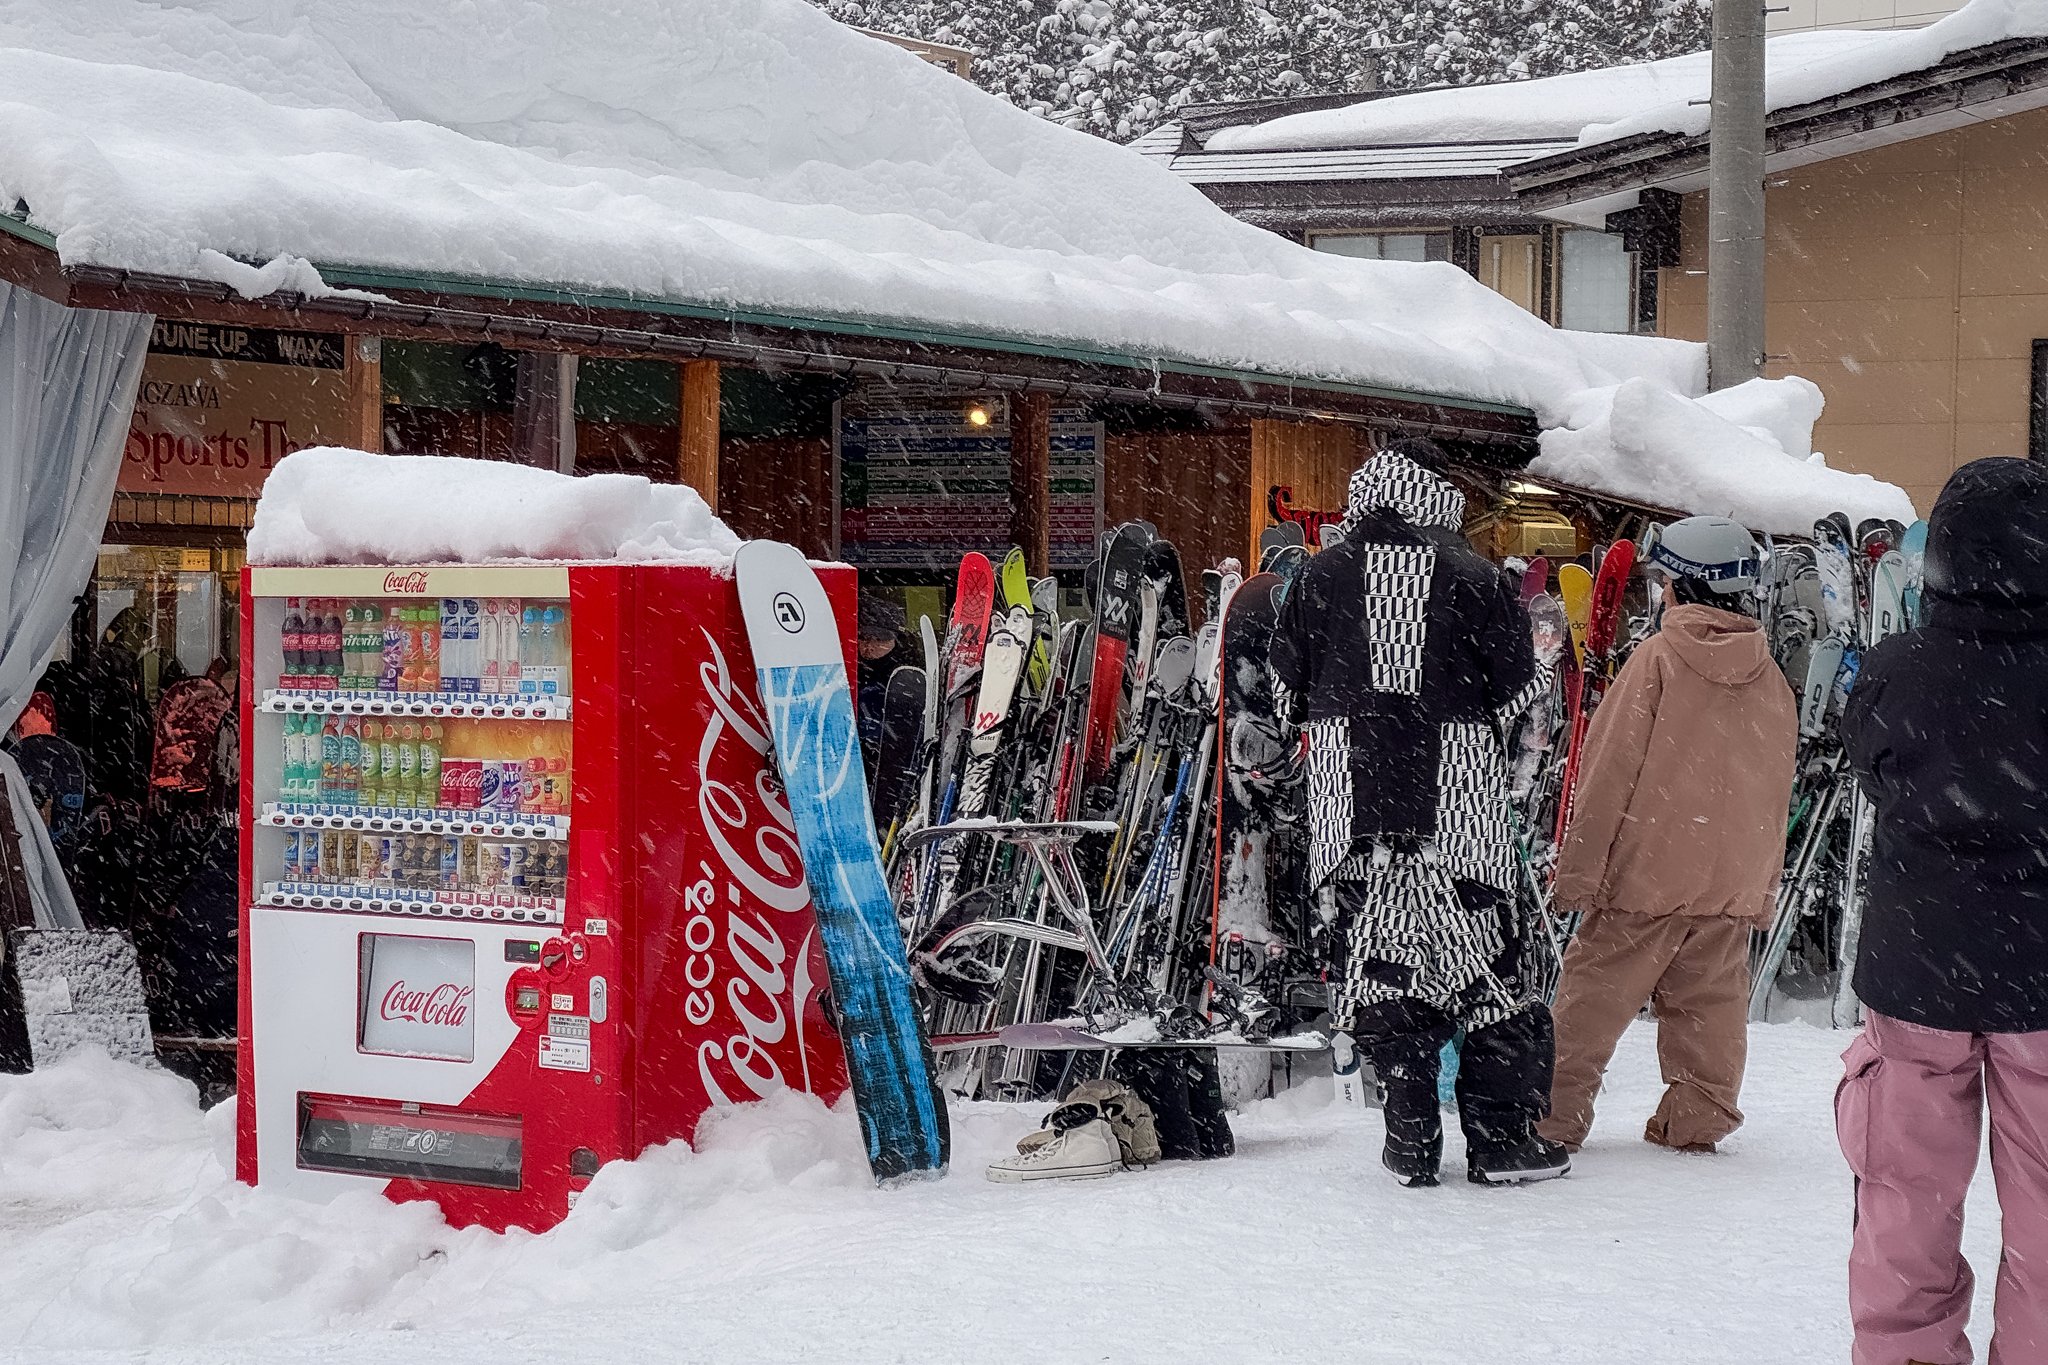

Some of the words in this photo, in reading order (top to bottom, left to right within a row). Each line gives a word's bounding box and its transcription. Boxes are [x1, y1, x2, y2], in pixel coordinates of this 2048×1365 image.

[277, 334, 325, 359] WAX
[126, 410, 249, 482] Sports
[383, 571, 430, 593] Coca-Cola
[384, 630, 400, 641] NTA
[1806, 683, 1823, 728] EAD
[503, 771, 520, 783] NTA
[380, 980, 475, 1028] Coca-Cola
